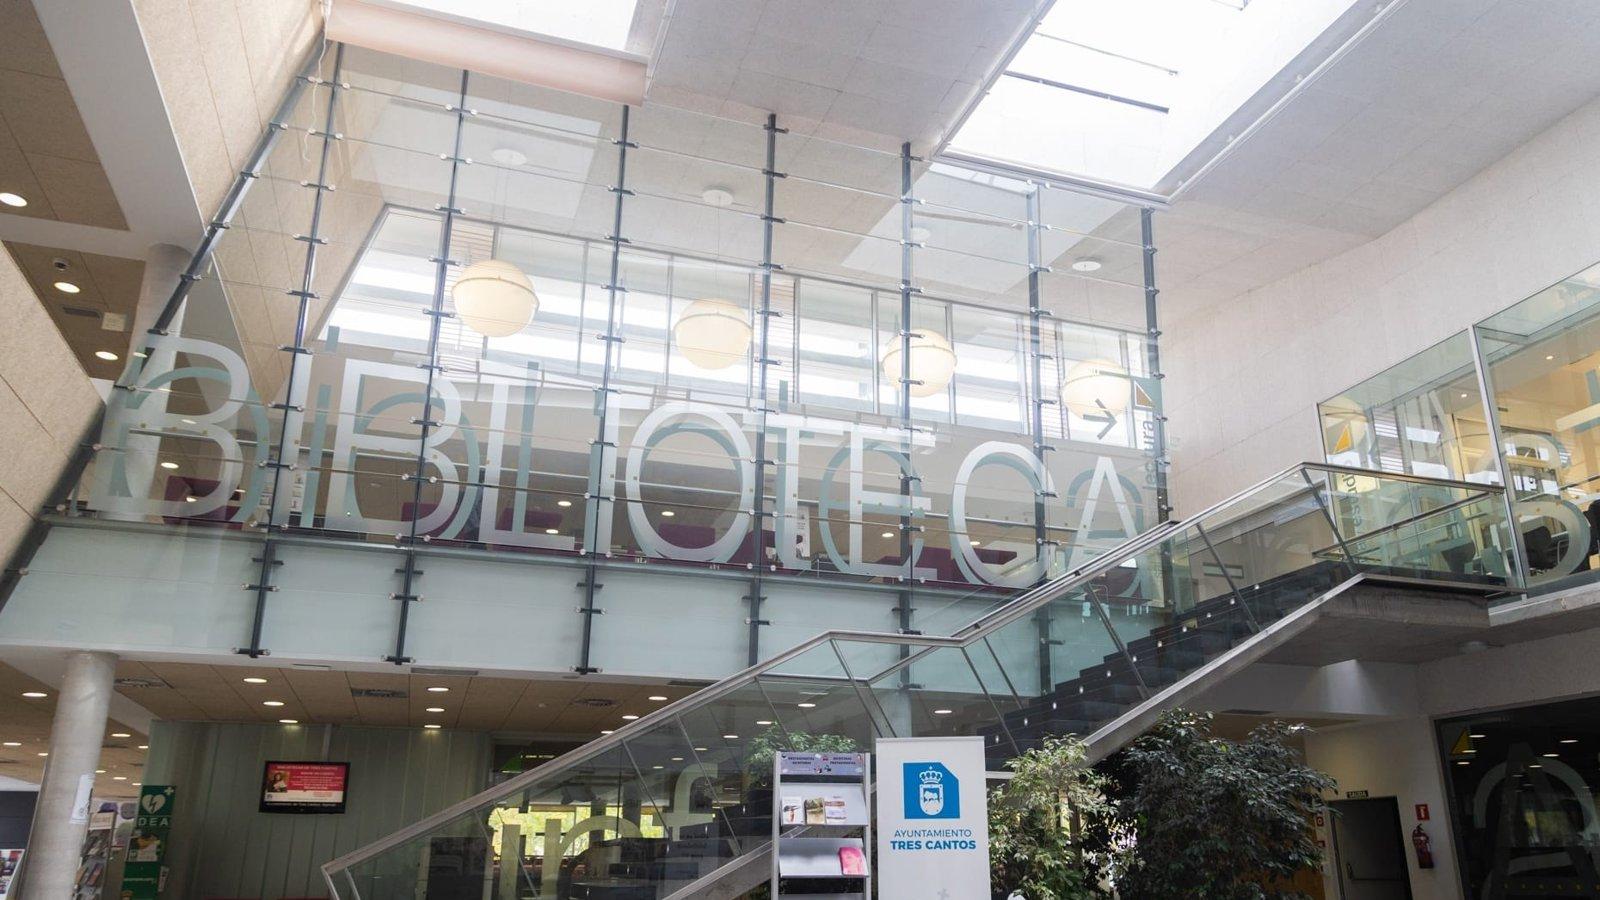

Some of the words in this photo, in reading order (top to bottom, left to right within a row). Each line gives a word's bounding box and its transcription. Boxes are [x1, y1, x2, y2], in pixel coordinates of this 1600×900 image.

[87, 333, 1164, 607] BIBLIOTECA
[138, 817, 169, 826] DEA
[894, 829, 972, 838] AYUNTAMIENTO
[890, 840, 922, 850] TRES
[925, 840, 976, 850] CANTOS
